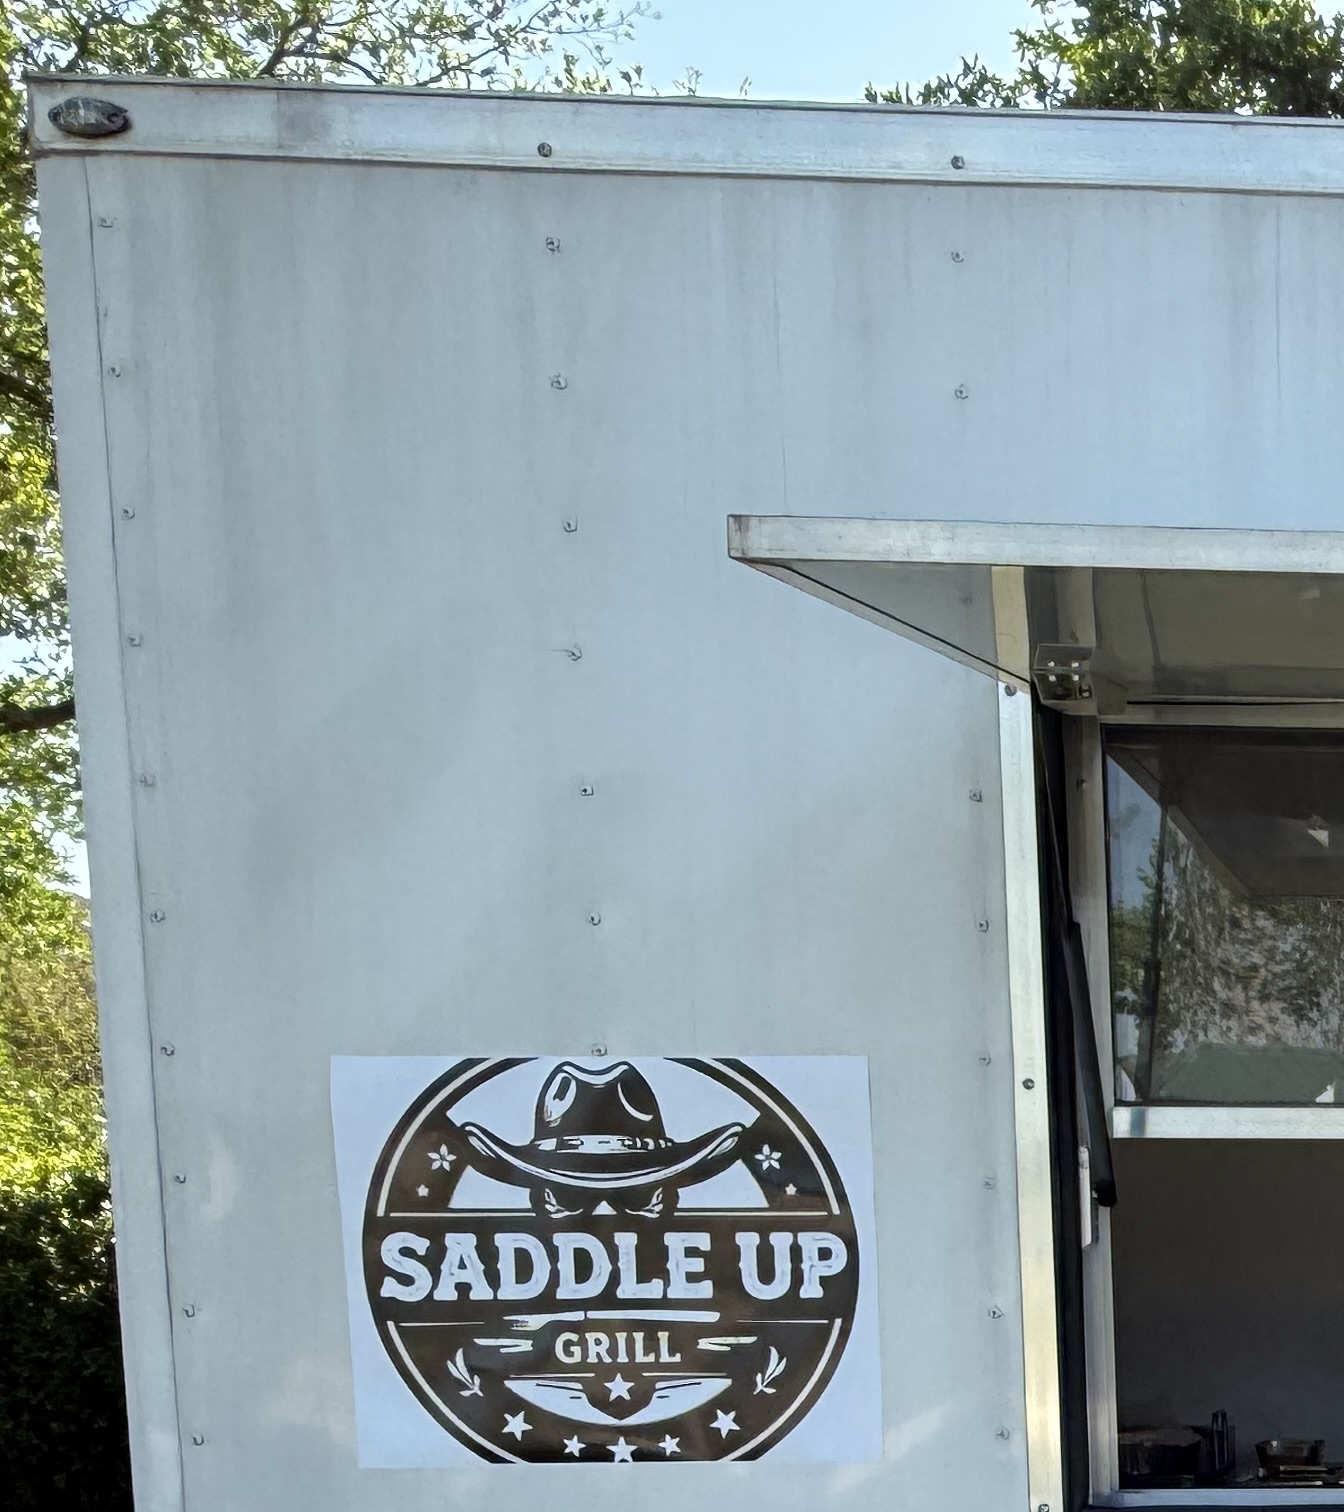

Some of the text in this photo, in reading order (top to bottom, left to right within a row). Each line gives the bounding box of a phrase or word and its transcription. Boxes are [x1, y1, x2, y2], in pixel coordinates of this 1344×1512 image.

[380, 1231, 848, 1301] SADDLE UP
[554, 1331, 682, 1364] GRILL
